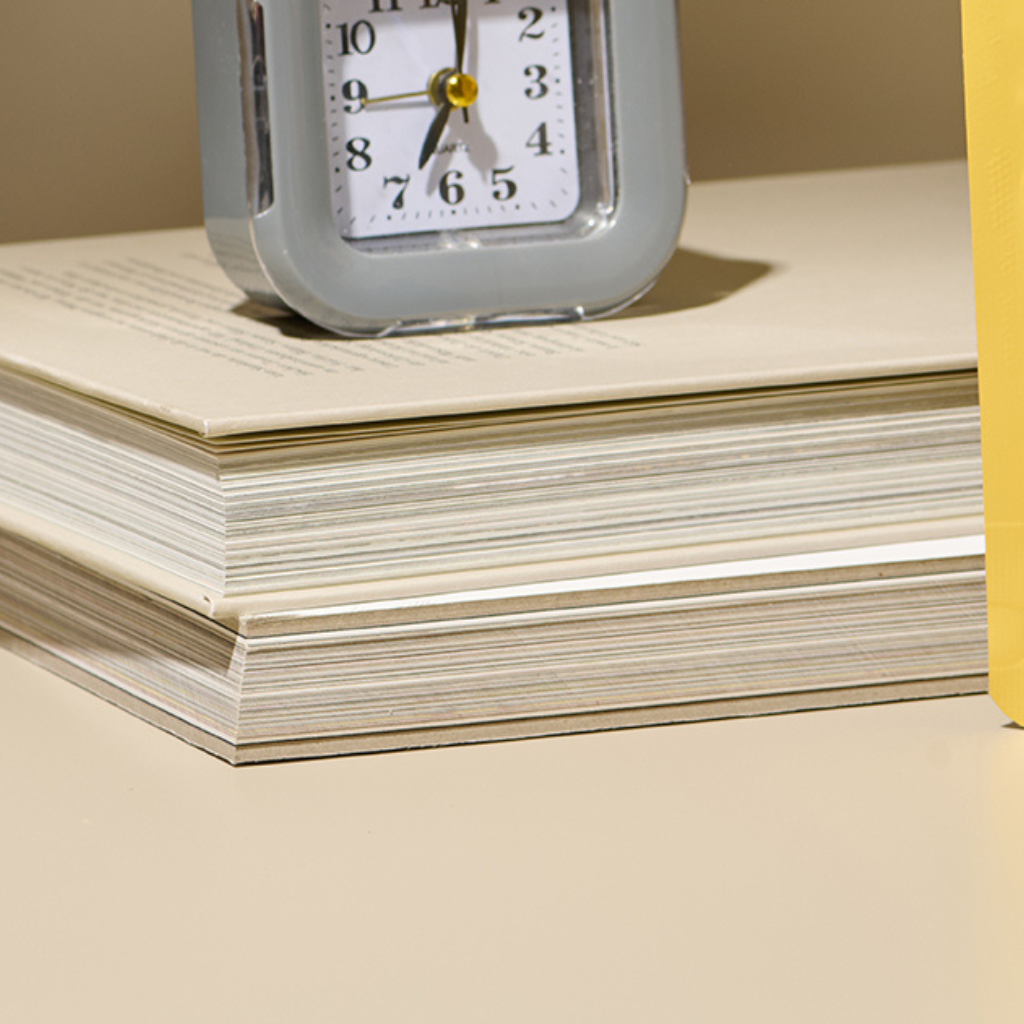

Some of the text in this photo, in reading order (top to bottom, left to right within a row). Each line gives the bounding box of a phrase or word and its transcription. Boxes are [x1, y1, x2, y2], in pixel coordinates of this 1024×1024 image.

[337, 20, 376, 56] 10
[518, 6, 545, 42] 2
[341, 79, 368, 114] 9
[523, 65, 549, 100] 3
[345, 137, 372, 171] 8
[525, 122, 551, 156] 4
[383, 174, 410, 209] 7
[438, 170, 465, 205] 6
[491, 166, 518, 201] 5
